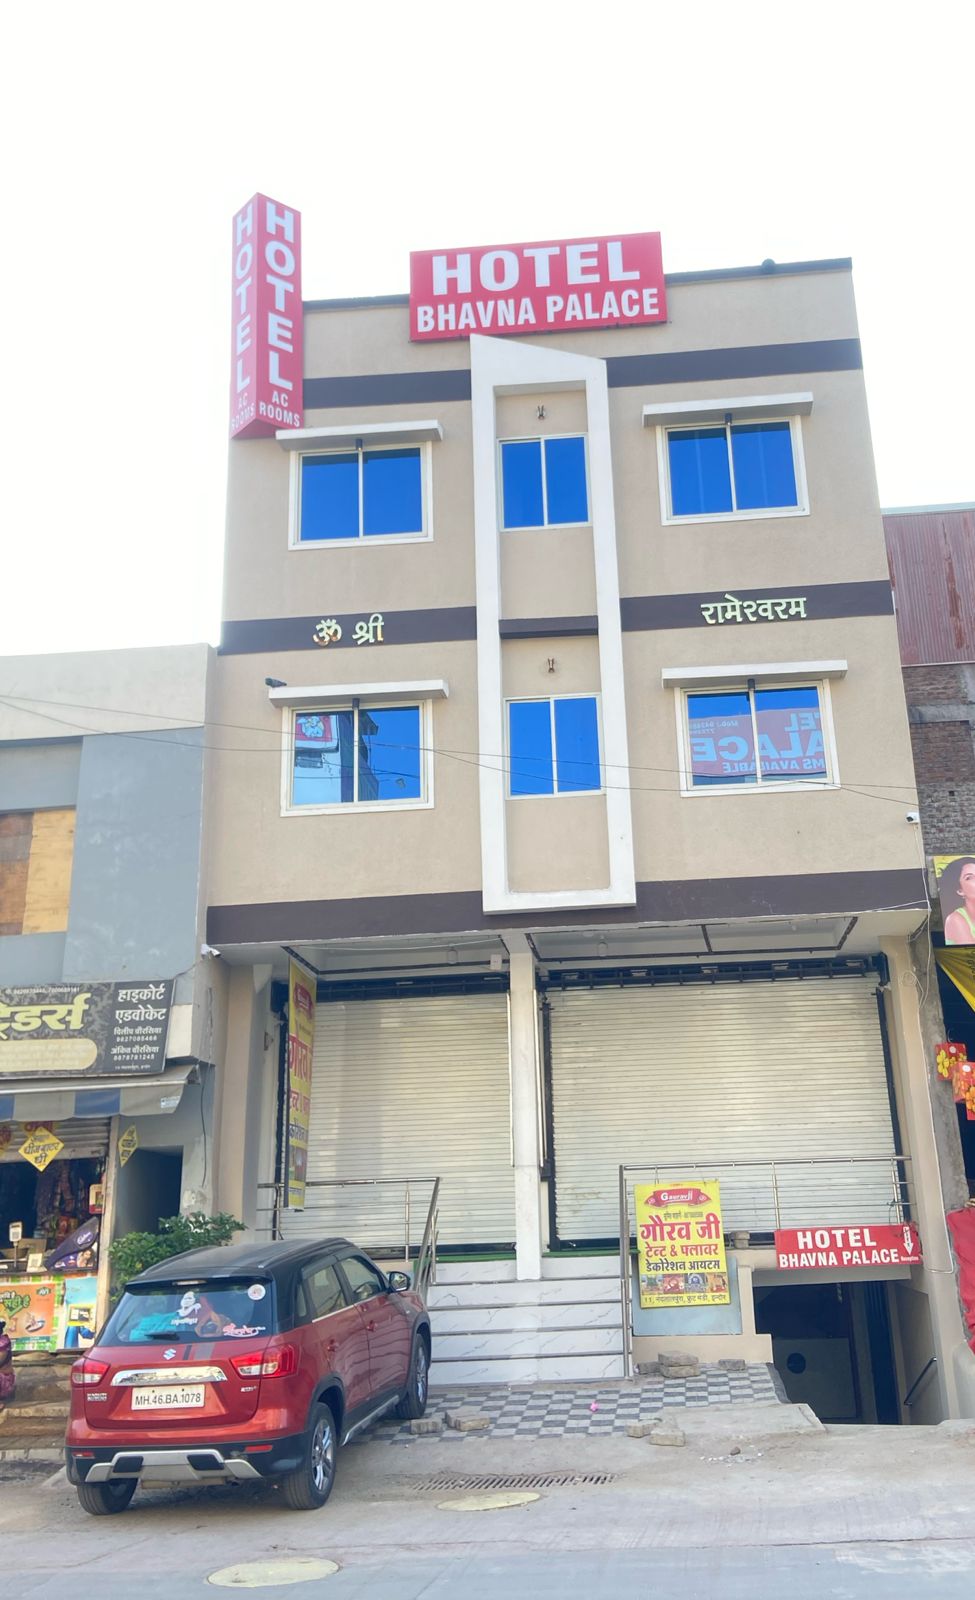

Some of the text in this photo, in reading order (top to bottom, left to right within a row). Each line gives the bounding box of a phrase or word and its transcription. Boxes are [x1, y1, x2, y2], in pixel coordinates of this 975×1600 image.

[432, 241, 640, 296] HOTEL
[235, 202, 253, 393] HOTEL
[265, 200, 296, 391] HOTEL
[417, 288, 659, 333] BHAVNA PALACE
[271, 391, 288, 407] AC
[259, 401, 300, 428] ROOMS
[700, 593, 807, 624] रामेश्वरम
[352, 613, 385, 645] श्री
[117, 983, 166, 1003] हाइकोर्ट
[115, 1004, 168, 1024] एडवोकेट
[639, 1212, 721, 1242] गौरव जी
[796, 1228, 877, 1249] HOTEL
[670, 1244, 678, 1257] &
[779, 1248, 900, 1268] BHAVNA PALACE
[645, 1258, 686, 1272] डेकोरेशन
